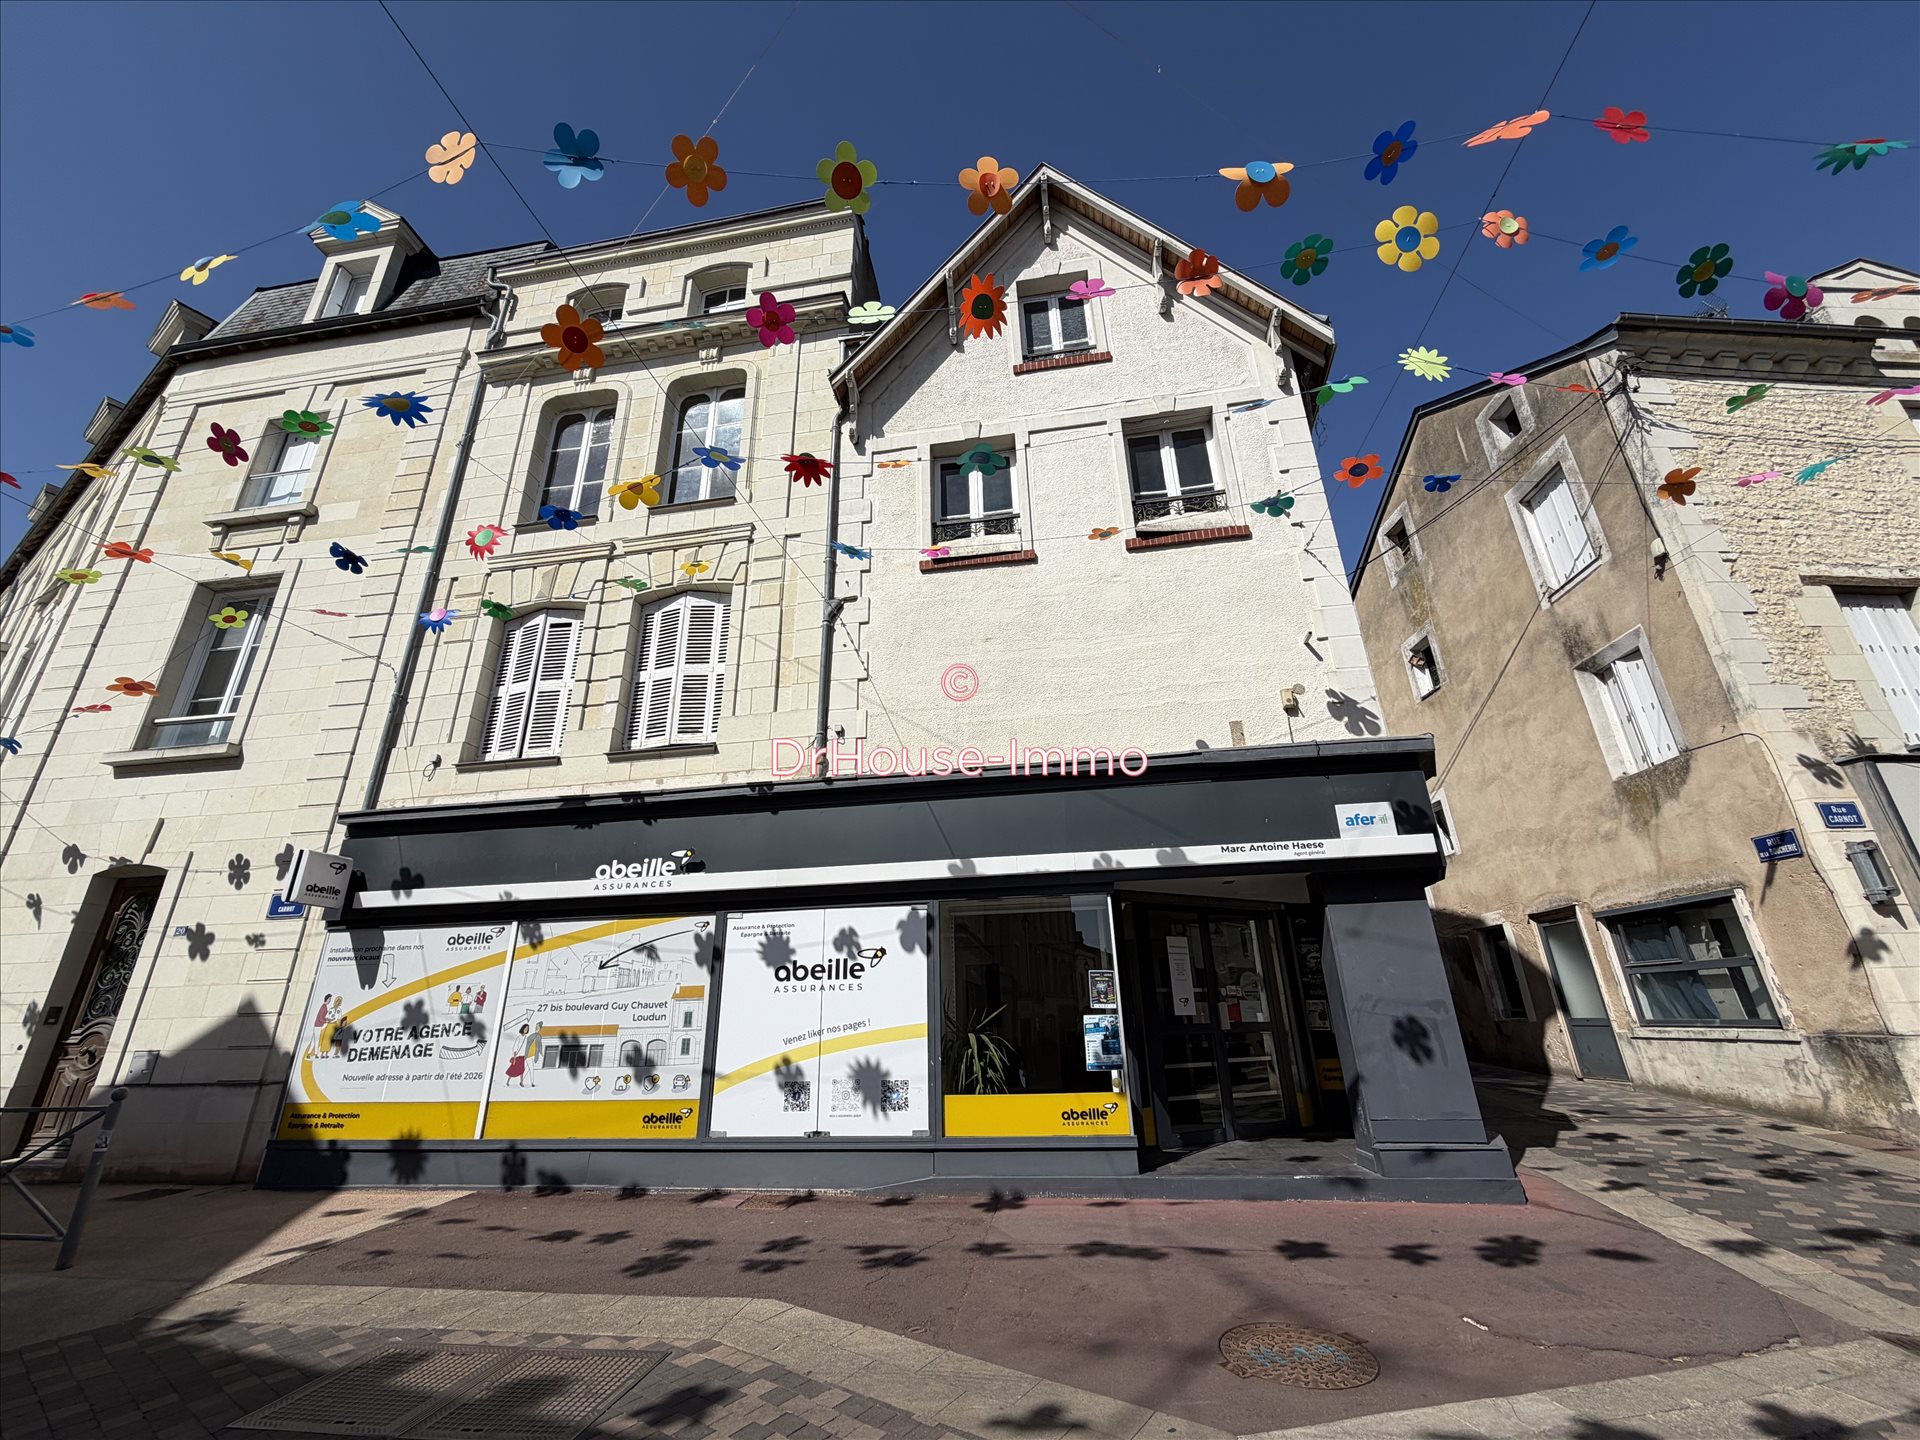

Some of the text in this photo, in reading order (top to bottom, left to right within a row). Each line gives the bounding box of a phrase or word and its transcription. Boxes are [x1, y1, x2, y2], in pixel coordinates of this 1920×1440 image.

[1830, 805, 1847, 813] Rue
[1345, 813, 1376, 827] afer
[1828, 815, 1859, 823] CARNOT
[1220, 841, 1324, 853] Marc Antoine Haese
[595, 857, 676, 880] abeille
[306, 882, 341, 896] abeille
[593, 880, 673, 891] ASSURANCES
[176, 927, 186, 935] 20
[447, 932, 494, 946] abeille
[327, 953, 380, 962] nouveaux locaux
[774, 958, 866, 982] abeille
[773, 983, 864, 994] ASSURANCES
[537, 1000, 668, 1012] 27 bis boulevard Guy Chauvet
[632, 1013, 667, 1022] Loudun
[352, 1021, 473, 1044] VOTRE AGENCE
[782, 1033, 807, 1046] Venez
[807, 1027, 825, 1040] liker
[826, 1024, 842, 1035] nos
[842, 1020, 867, 1033] pages
[346, 1042, 435, 1063] DEMENAGE
[342, 1071, 484, 1083] Nouvelle adresse à partir de l'été 2026
[642, 1112, 683, 1125] abeille
[1061, 1107, 1109, 1121] abeille
[313, 1121, 319, 1129] &
[319, 1121, 345, 1129] Retraite
